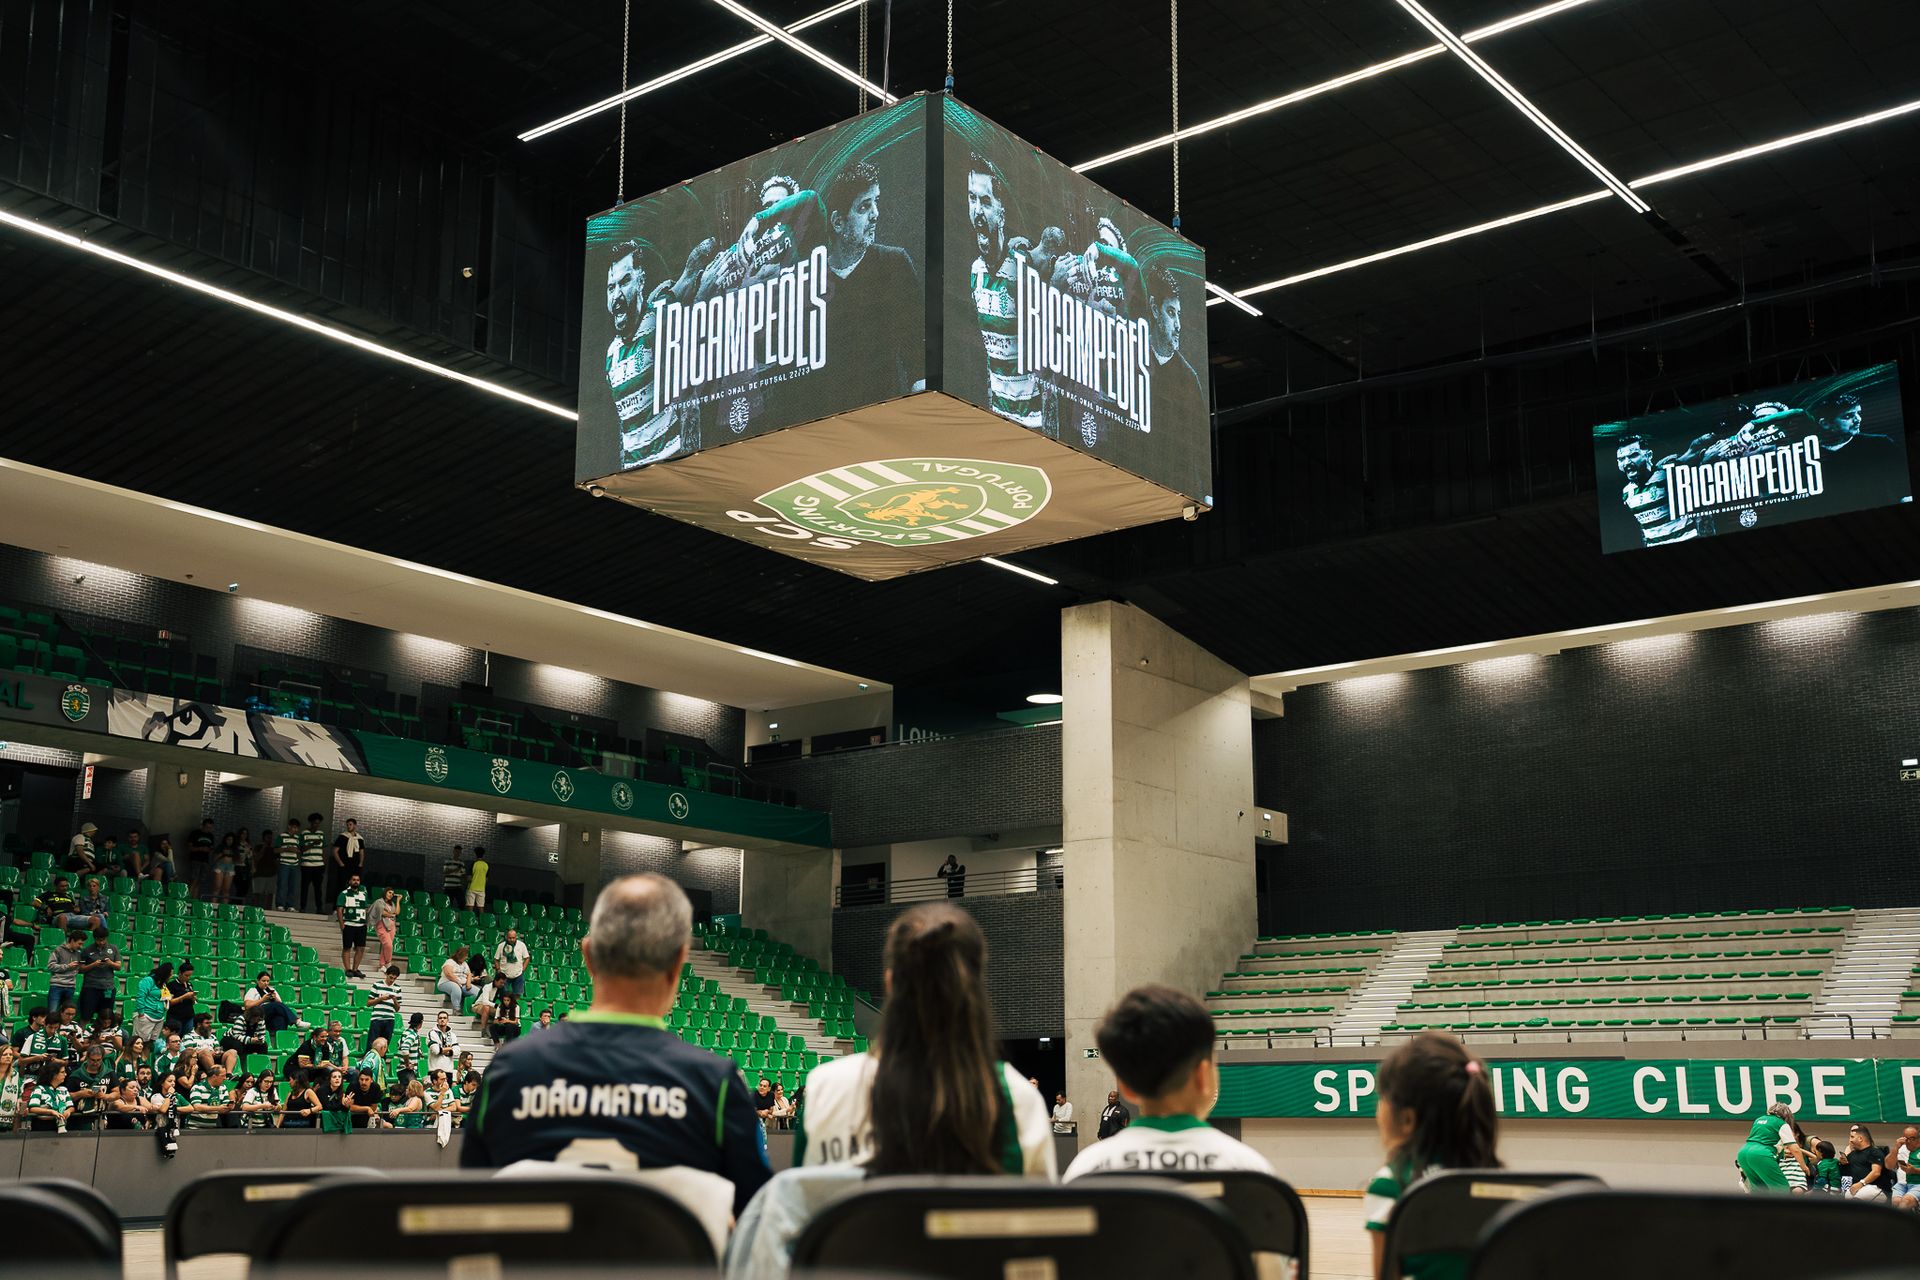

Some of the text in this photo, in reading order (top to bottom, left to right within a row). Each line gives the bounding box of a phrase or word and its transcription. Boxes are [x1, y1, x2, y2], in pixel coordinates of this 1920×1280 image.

[653, 245, 828, 416] TRICAMPEÕES
[1014, 251, 1151, 434] TRICAMPEÕES
[710, 385, 746, 402] NACONAL
[748, 381, 758, 391] DE
[759, 375, 788, 388] FUTSAL
[1066, 391, 1094, 410] NACONAL
[911, 461, 1034, 510] PORTUGAL
[1663, 434, 1824, 521] TRICAMPEÕES
[724, 509, 862, 550] SCP
[792, 494, 932, 541] SPORTING
[67, 684, 88, 693] SCP
[512, 1078, 688, 1120] JOÃO MATOS
[1312, 1066, 1591, 1113] SPING
[1632, 1066, 1851, 1116] CLUBE
